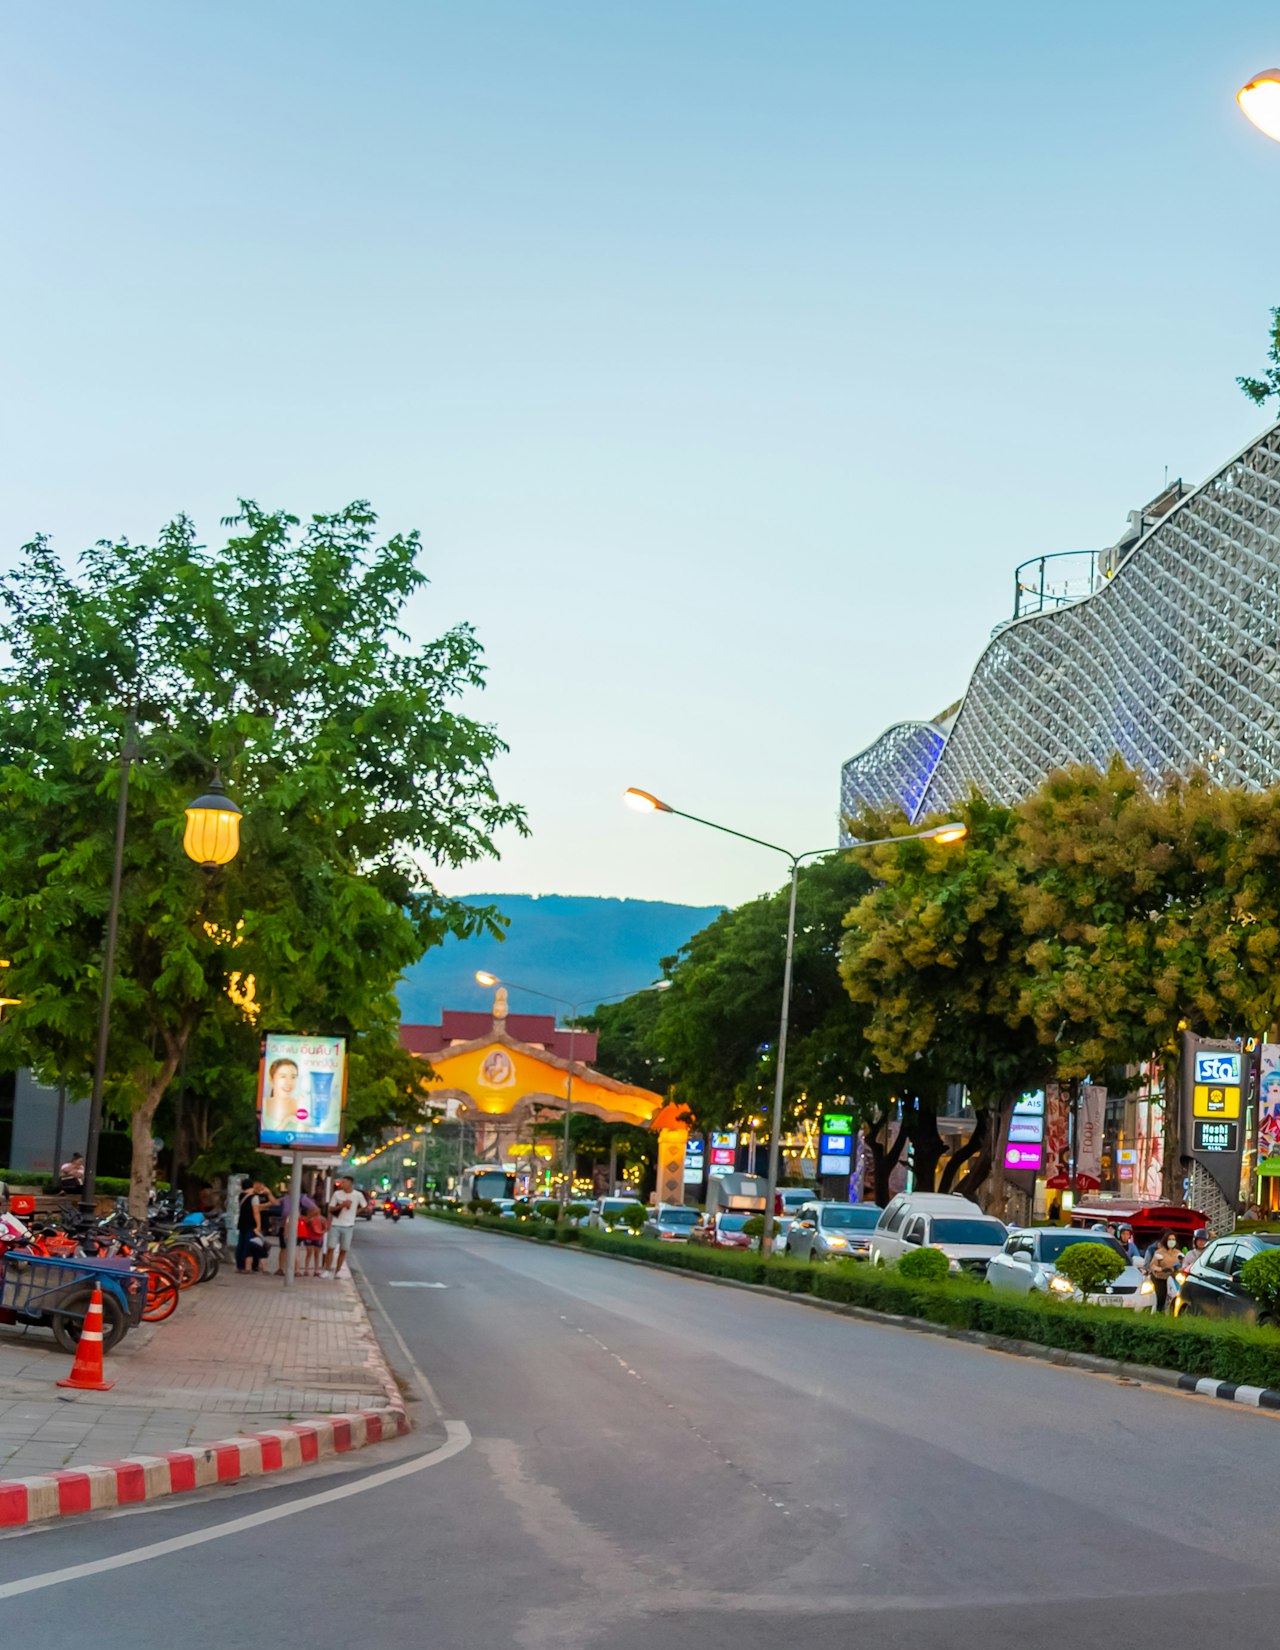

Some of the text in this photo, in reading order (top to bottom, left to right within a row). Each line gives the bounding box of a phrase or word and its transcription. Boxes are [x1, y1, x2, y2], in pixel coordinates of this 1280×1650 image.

[334, 1042, 341, 1057] 1
[1027, 1100, 1042, 1108] AIS
[1202, 1123, 1229, 1134] Moshi
[1083, 1121, 1095, 1154] FOOD
[1201, 1133, 1229, 1143] Moshi
